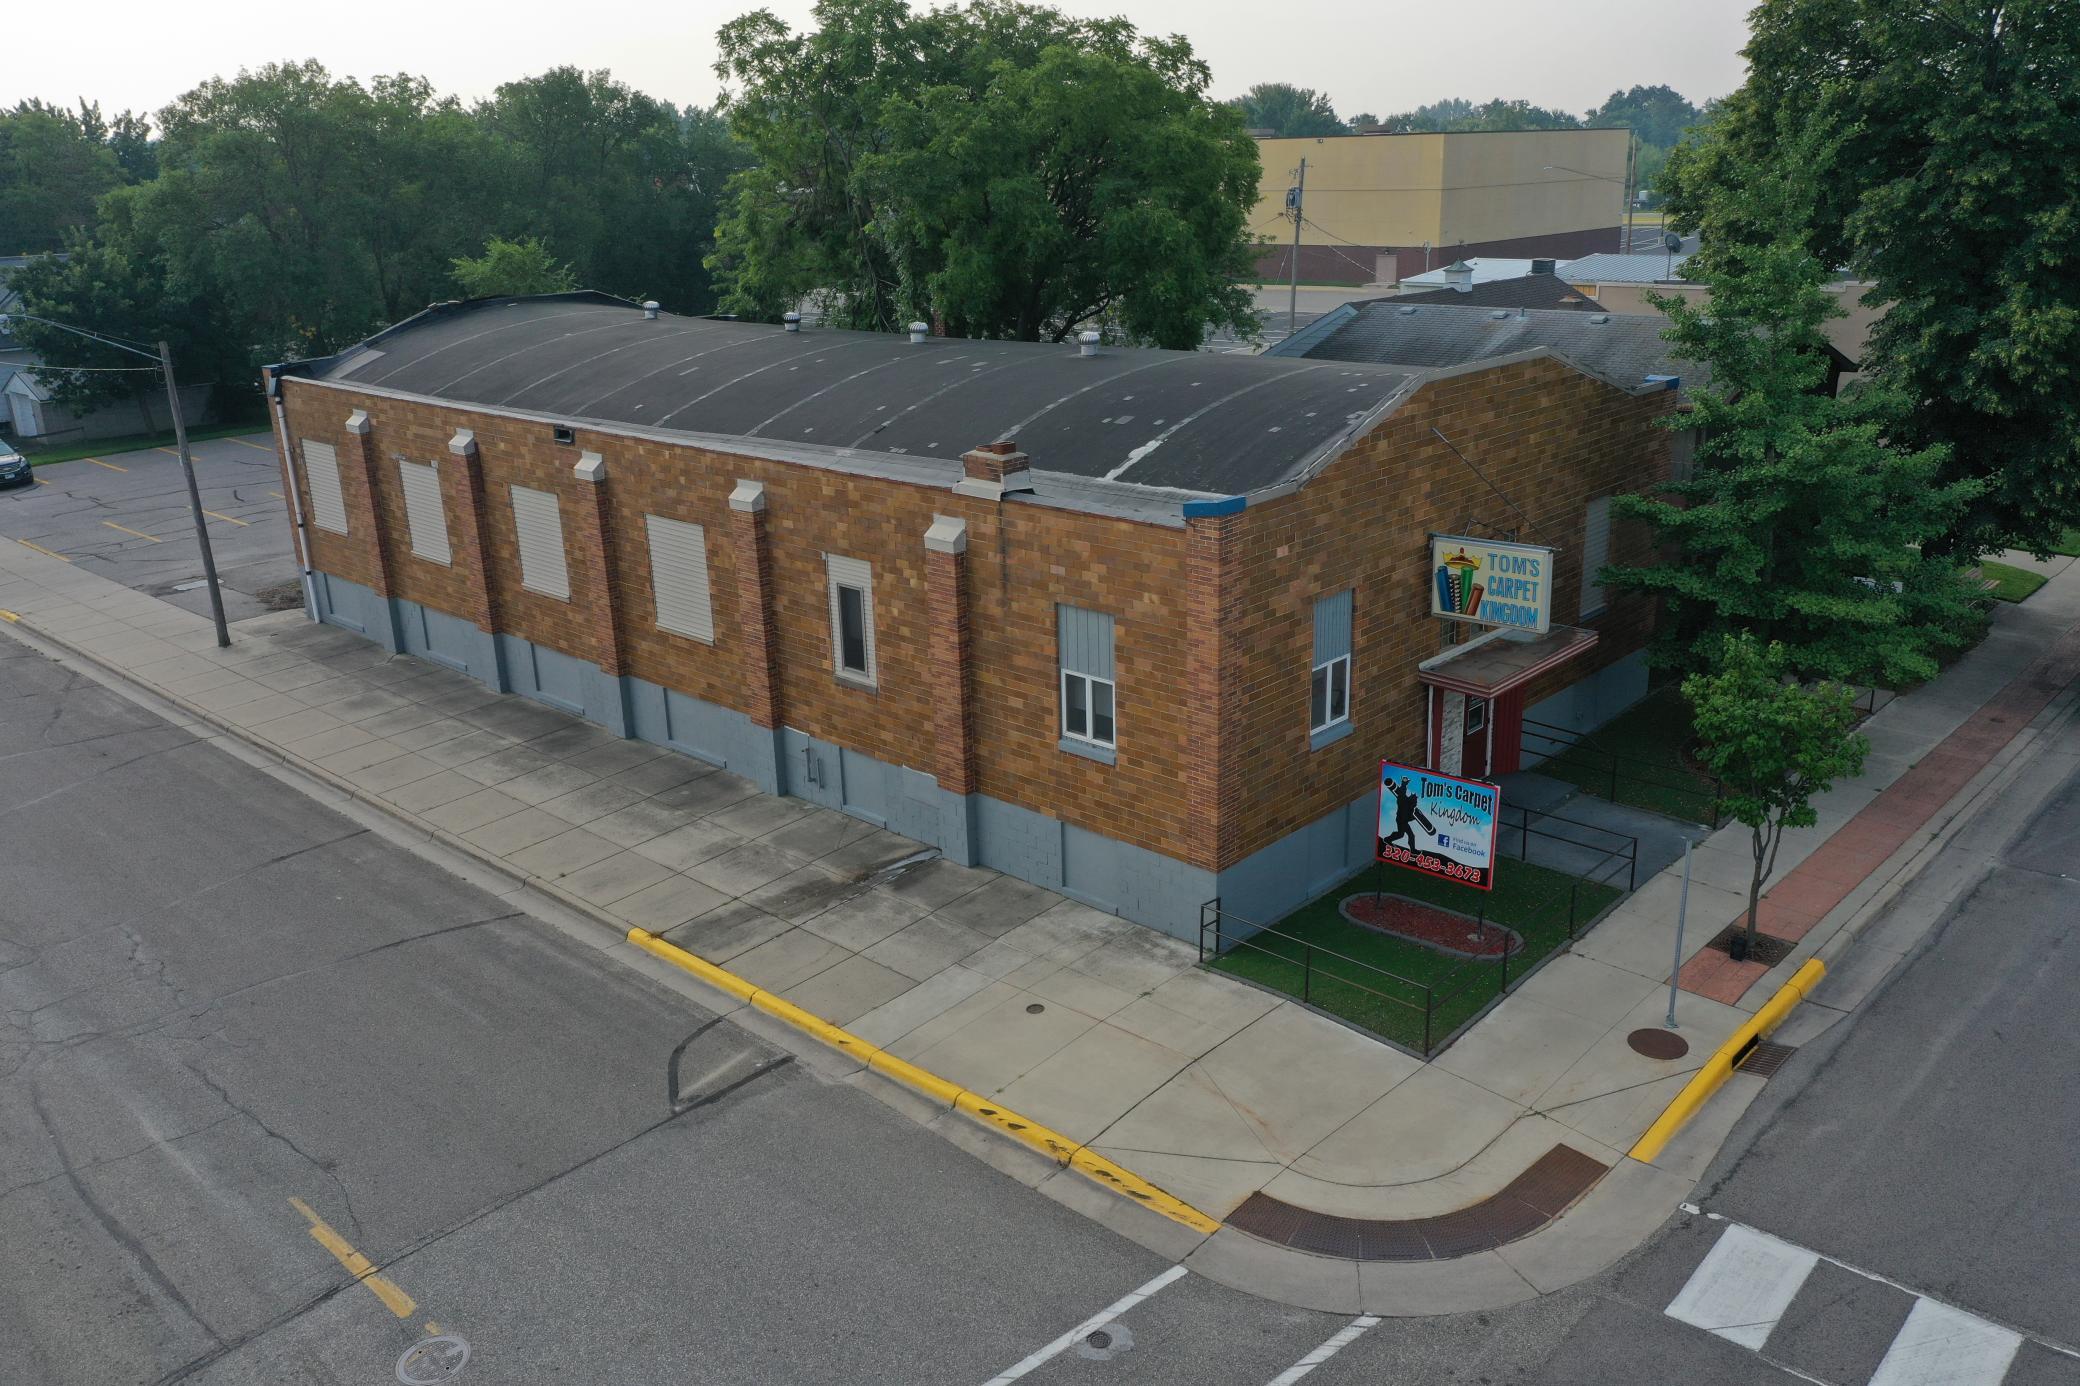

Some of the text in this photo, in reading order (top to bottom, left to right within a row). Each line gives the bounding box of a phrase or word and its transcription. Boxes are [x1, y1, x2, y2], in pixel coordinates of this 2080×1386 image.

[1488, 552, 1540, 577] TOM'S
[1488, 575, 1539, 602] CARPET
[1480, 599, 1539, 629] KINGDOM
[1420, 777, 1493, 816] Tom's Carpet
[1430, 801, 1481, 826] Kingdom
[1453, 843, 1485, 857] Facebook
